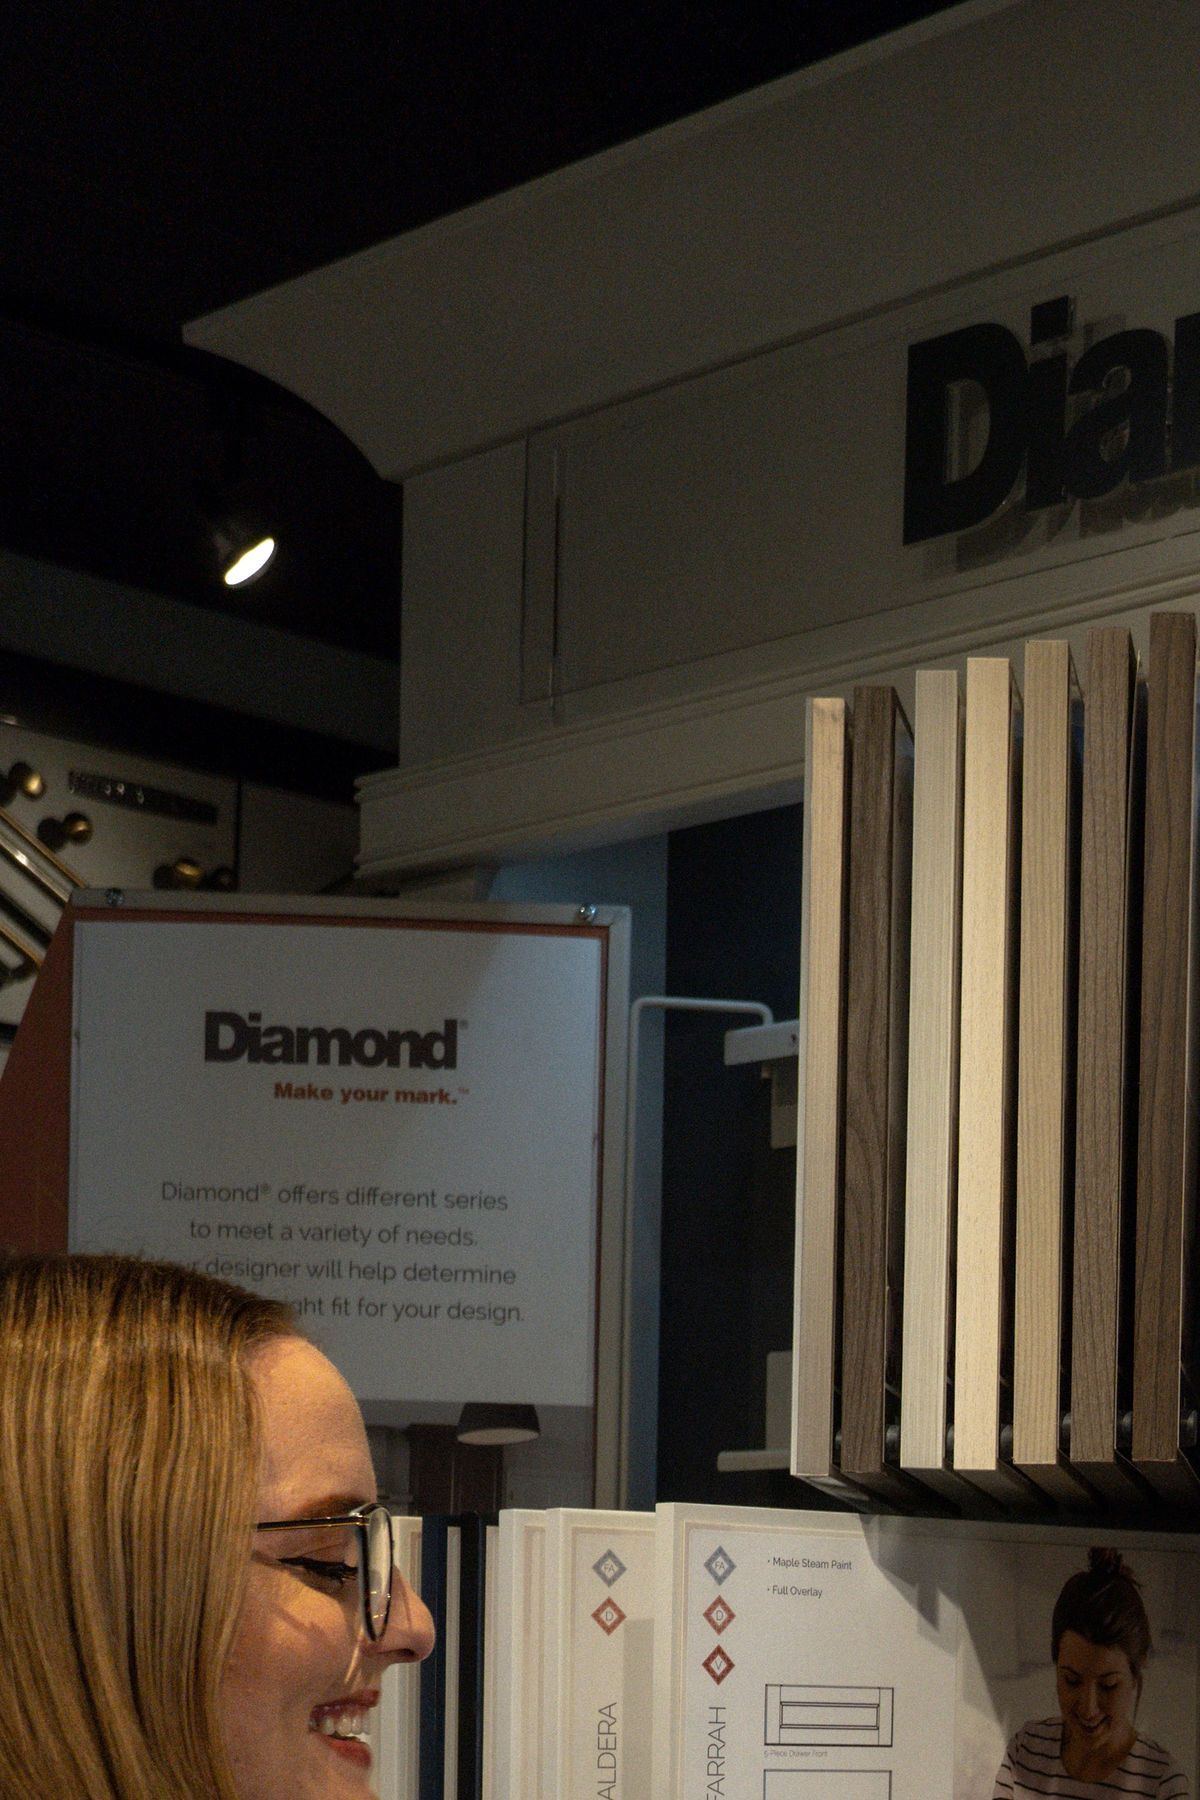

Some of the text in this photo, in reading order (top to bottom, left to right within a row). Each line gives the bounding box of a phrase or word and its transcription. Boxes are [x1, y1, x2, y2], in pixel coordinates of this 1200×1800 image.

[274, 1082, 334, 1100] Make
[341, 1087, 389, 1105] your
[278, 1185, 340, 1205] offers
[346, 1187, 438, 1209] different
[443, 1190, 509, 1211] series
[190, 1221, 478, 1248] to meet a variety of needs.
[206, 1258, 301, 1282] designer
[306, 1259, 343, 1279] will
[349, 1261, 397, 1285] help
[403, 1263, 517, 1285] determine
[332, 1297, 350, 1317] fit
[357, 1297, 388, 1318] for
[391, 1302, 441, 1323] your
[447, 1302, 525, 1327] design.
[772, 1557, 852, 1571] Maple Steam Paint
[772, 1585, 823, 1599] Full Overlay
[605, 1610, 614, 1622] D
[715, 1609, 724, 1621] D
[715, 1660, 723, 1671] V
